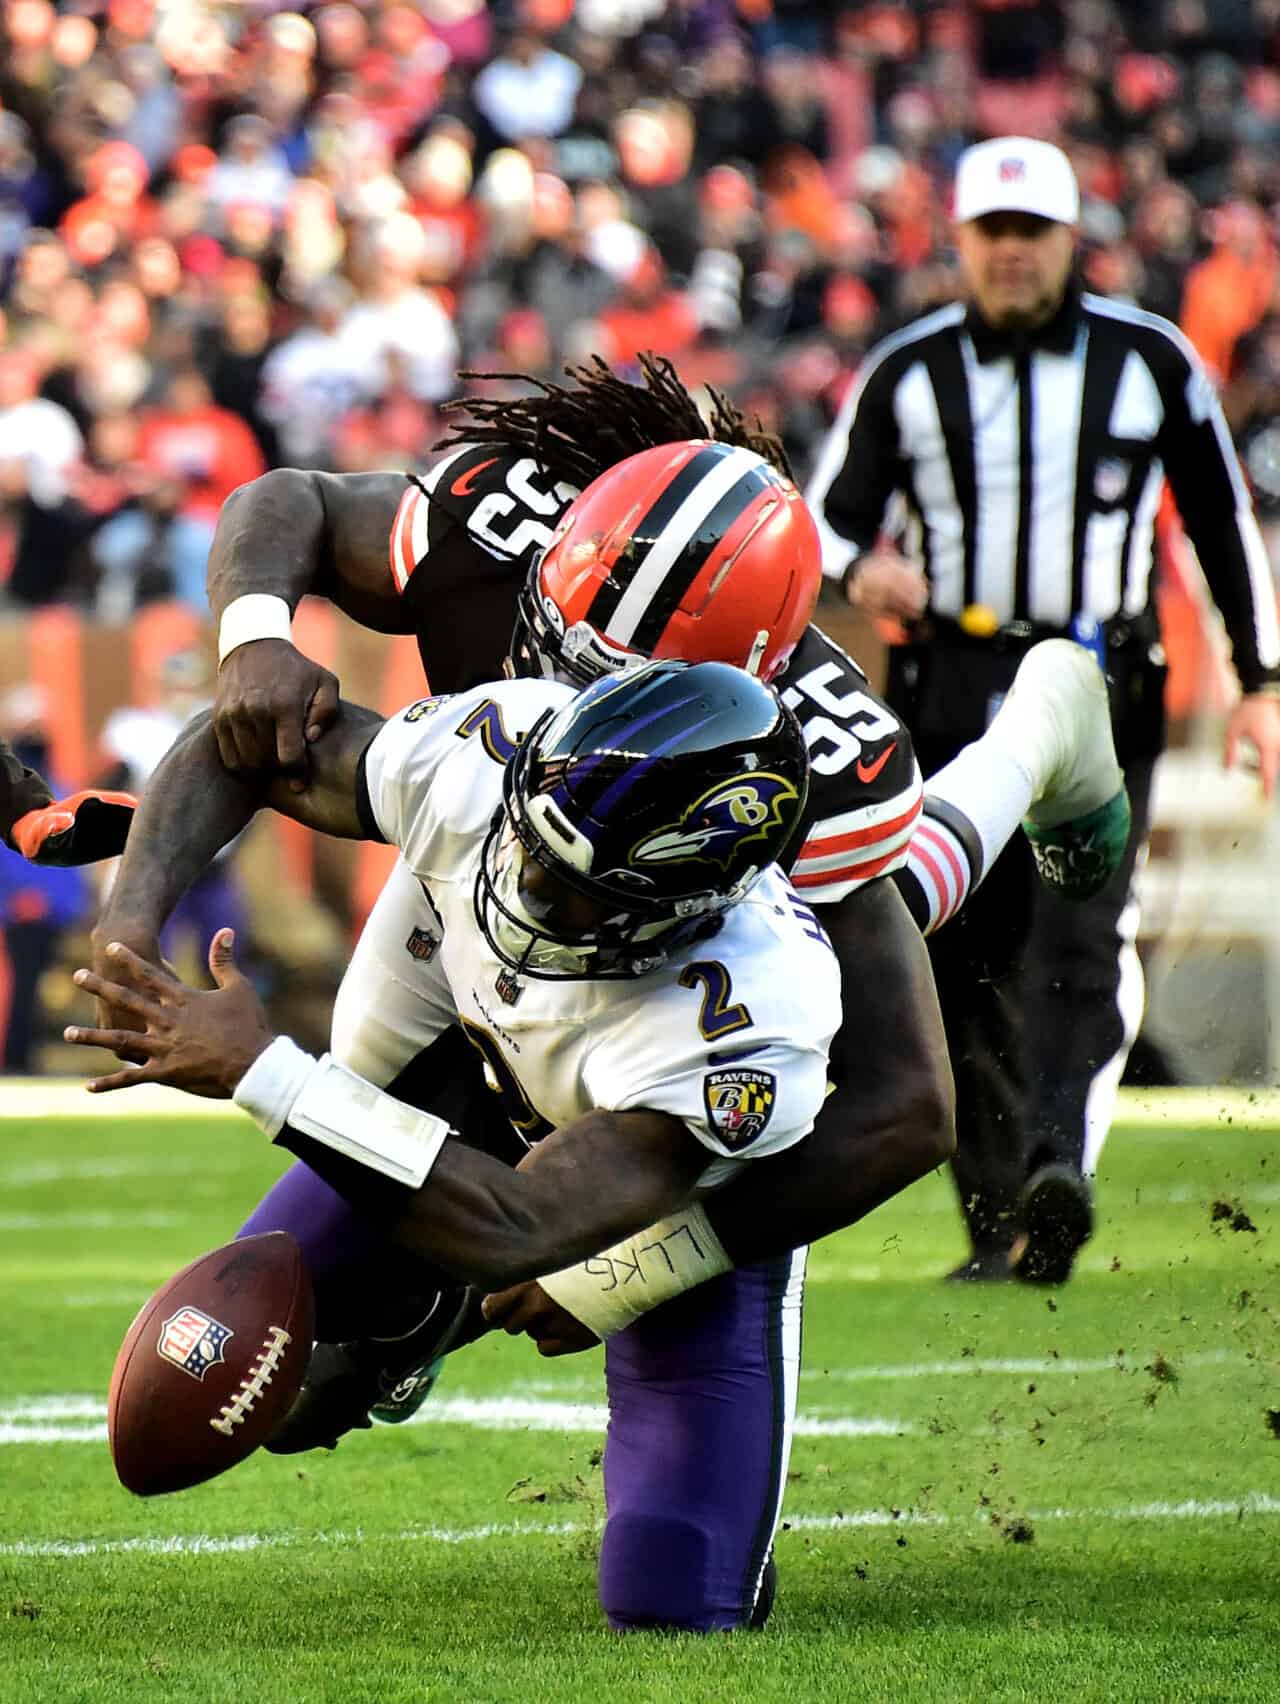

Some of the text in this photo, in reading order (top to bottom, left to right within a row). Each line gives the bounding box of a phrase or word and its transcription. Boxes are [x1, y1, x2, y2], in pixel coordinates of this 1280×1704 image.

[453, 697, 530, 767] 2
[779, 660, 901, 776] 55
[677, 959, 754, 1043] 2
[708, 1071, 773, 1086] RAVENS
[163, 1311, 207, 1358] NFL
